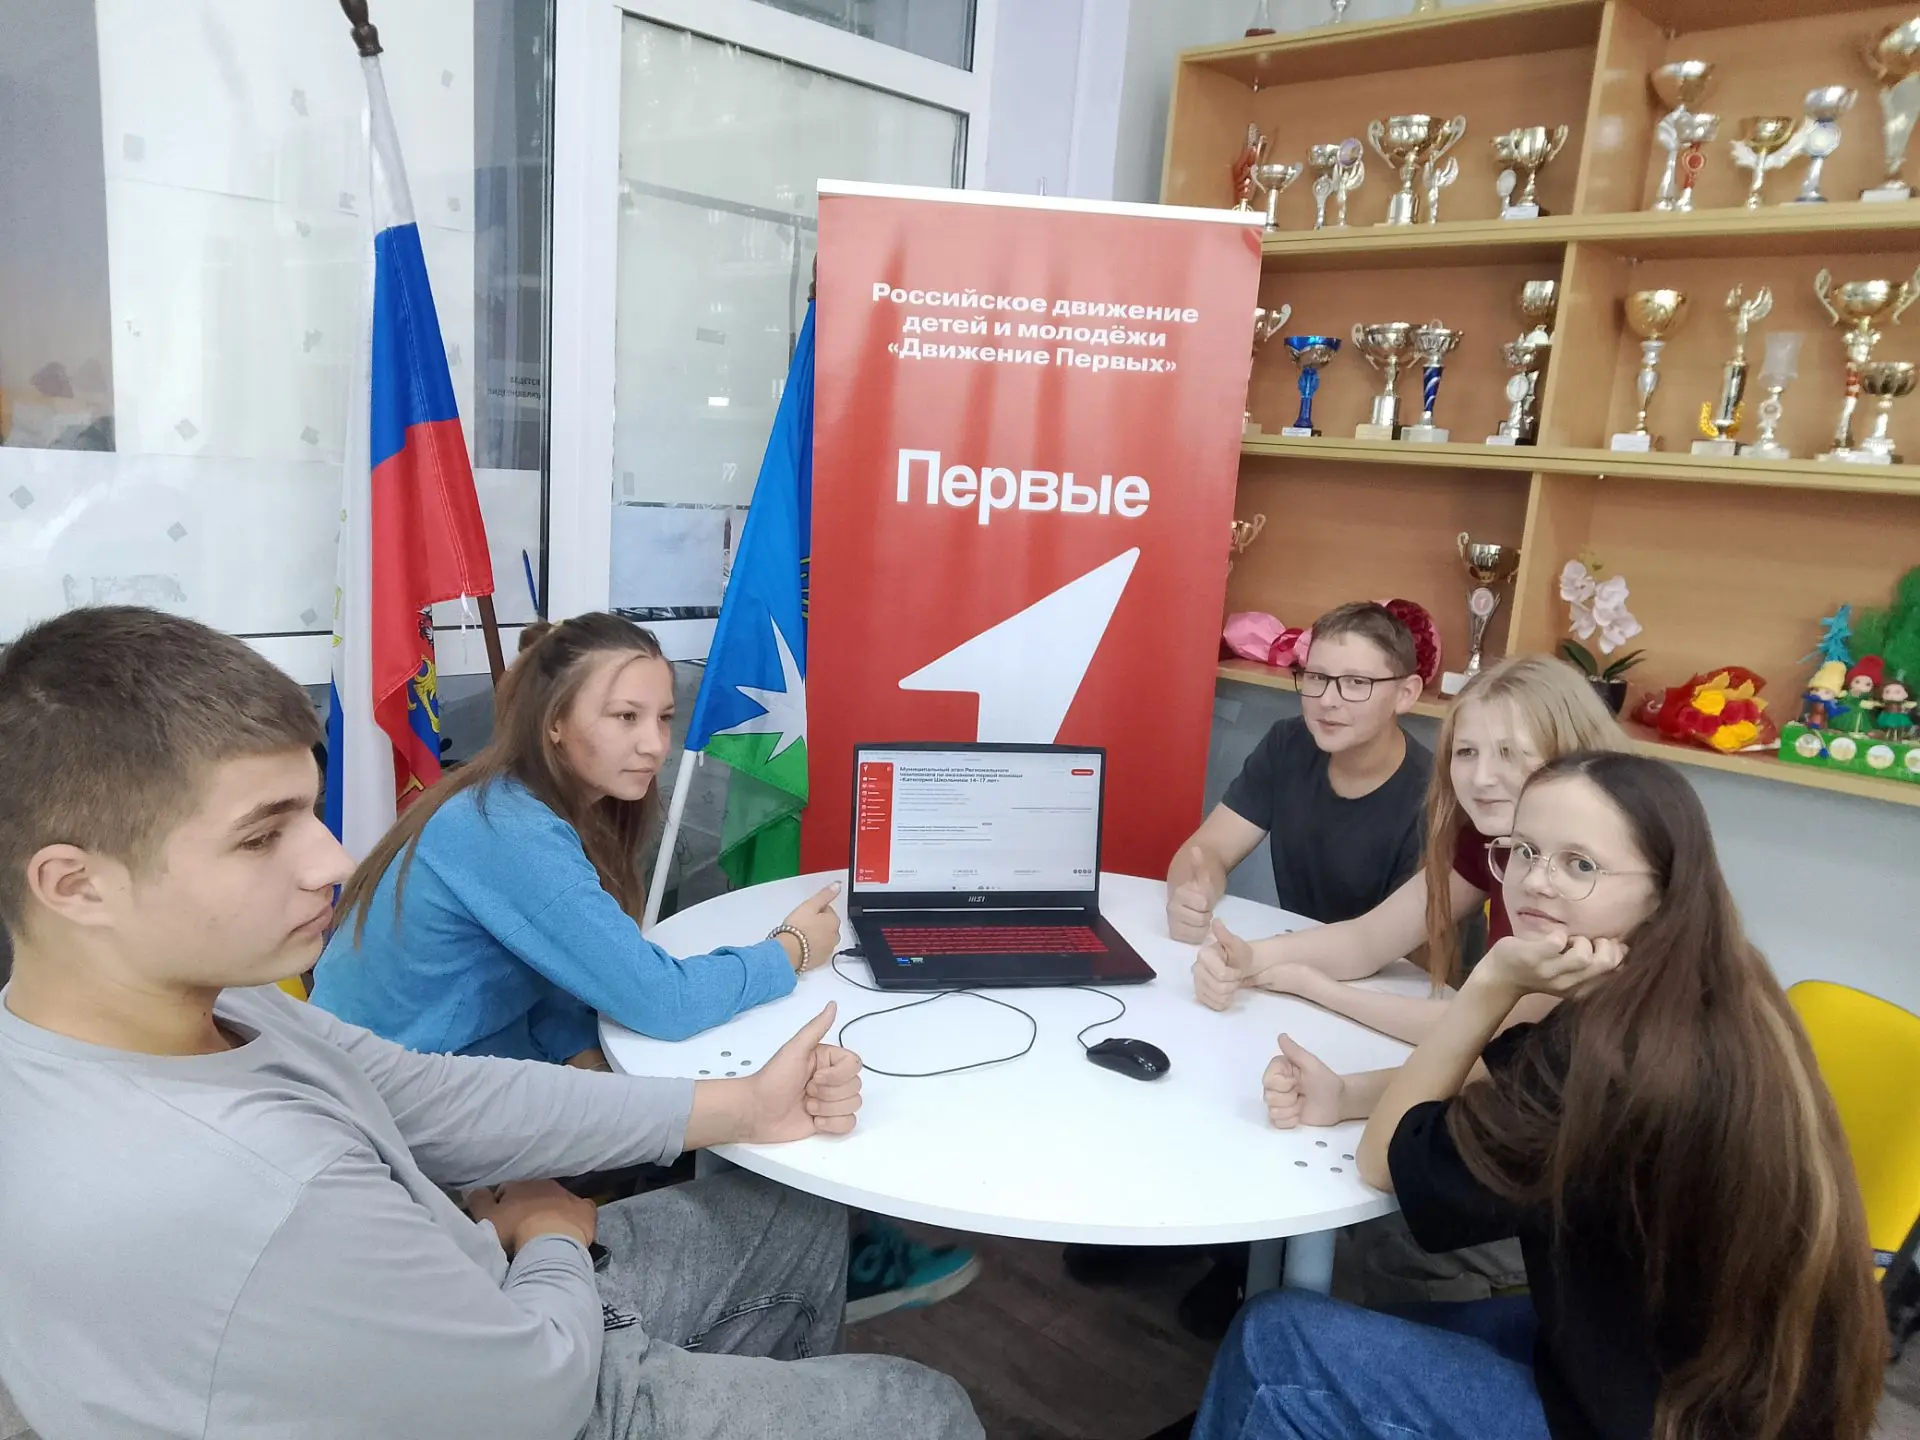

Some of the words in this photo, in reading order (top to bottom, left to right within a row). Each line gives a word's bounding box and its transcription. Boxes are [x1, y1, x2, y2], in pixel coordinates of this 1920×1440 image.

[872, 282, 1047, 314] Российское
[1052, 298, 1200, 324] движение
[902, 315, 988, 335] детей
[994, 321, 1011, 336] и
[1018, 323, 1167, 348] молодёжи
[887, 338, 1050, 366] «Движение
[1055, 348, 1178, 373] Первых»
[896, 448, 1151, 526] Первые
